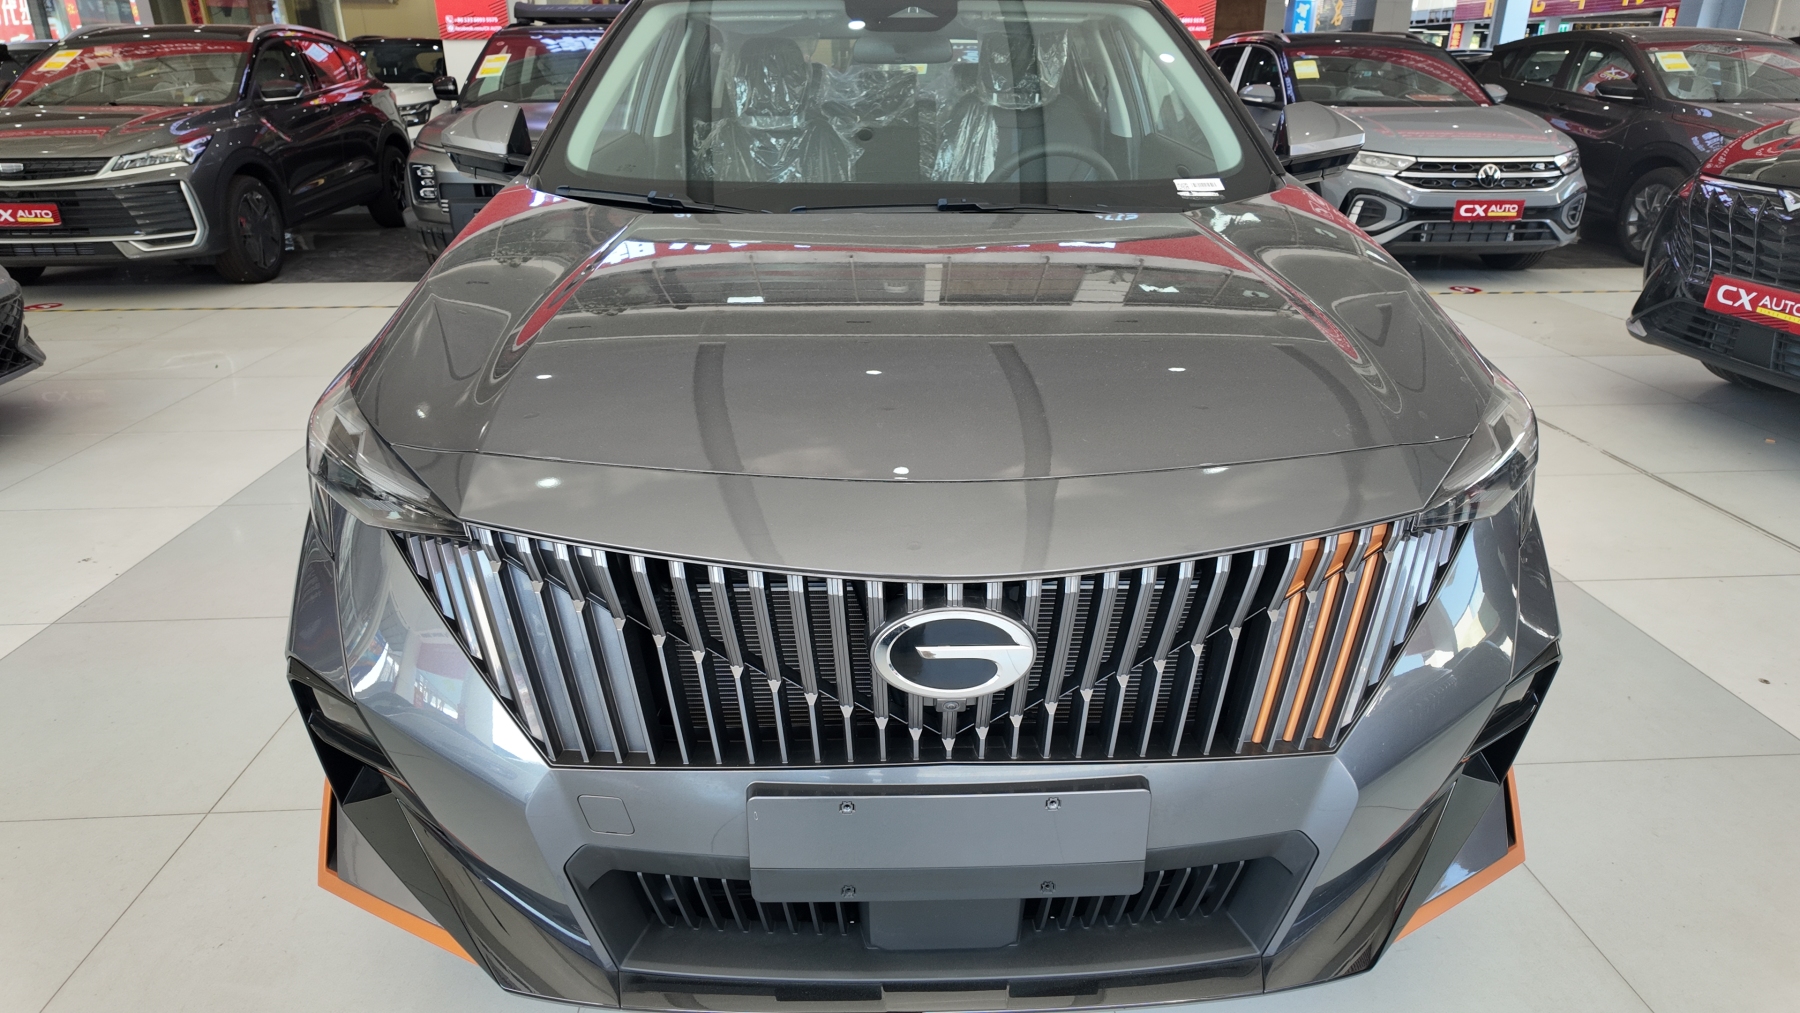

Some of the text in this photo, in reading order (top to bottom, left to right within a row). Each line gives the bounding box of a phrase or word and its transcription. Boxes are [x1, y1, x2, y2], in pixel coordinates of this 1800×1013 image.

[17, 209, 53, 218] AUTO
[1459, 204, 1488, 217] CX
[1488, 204, 1519, 213] AUTO
[1716, 284, 1758, 311] CX
